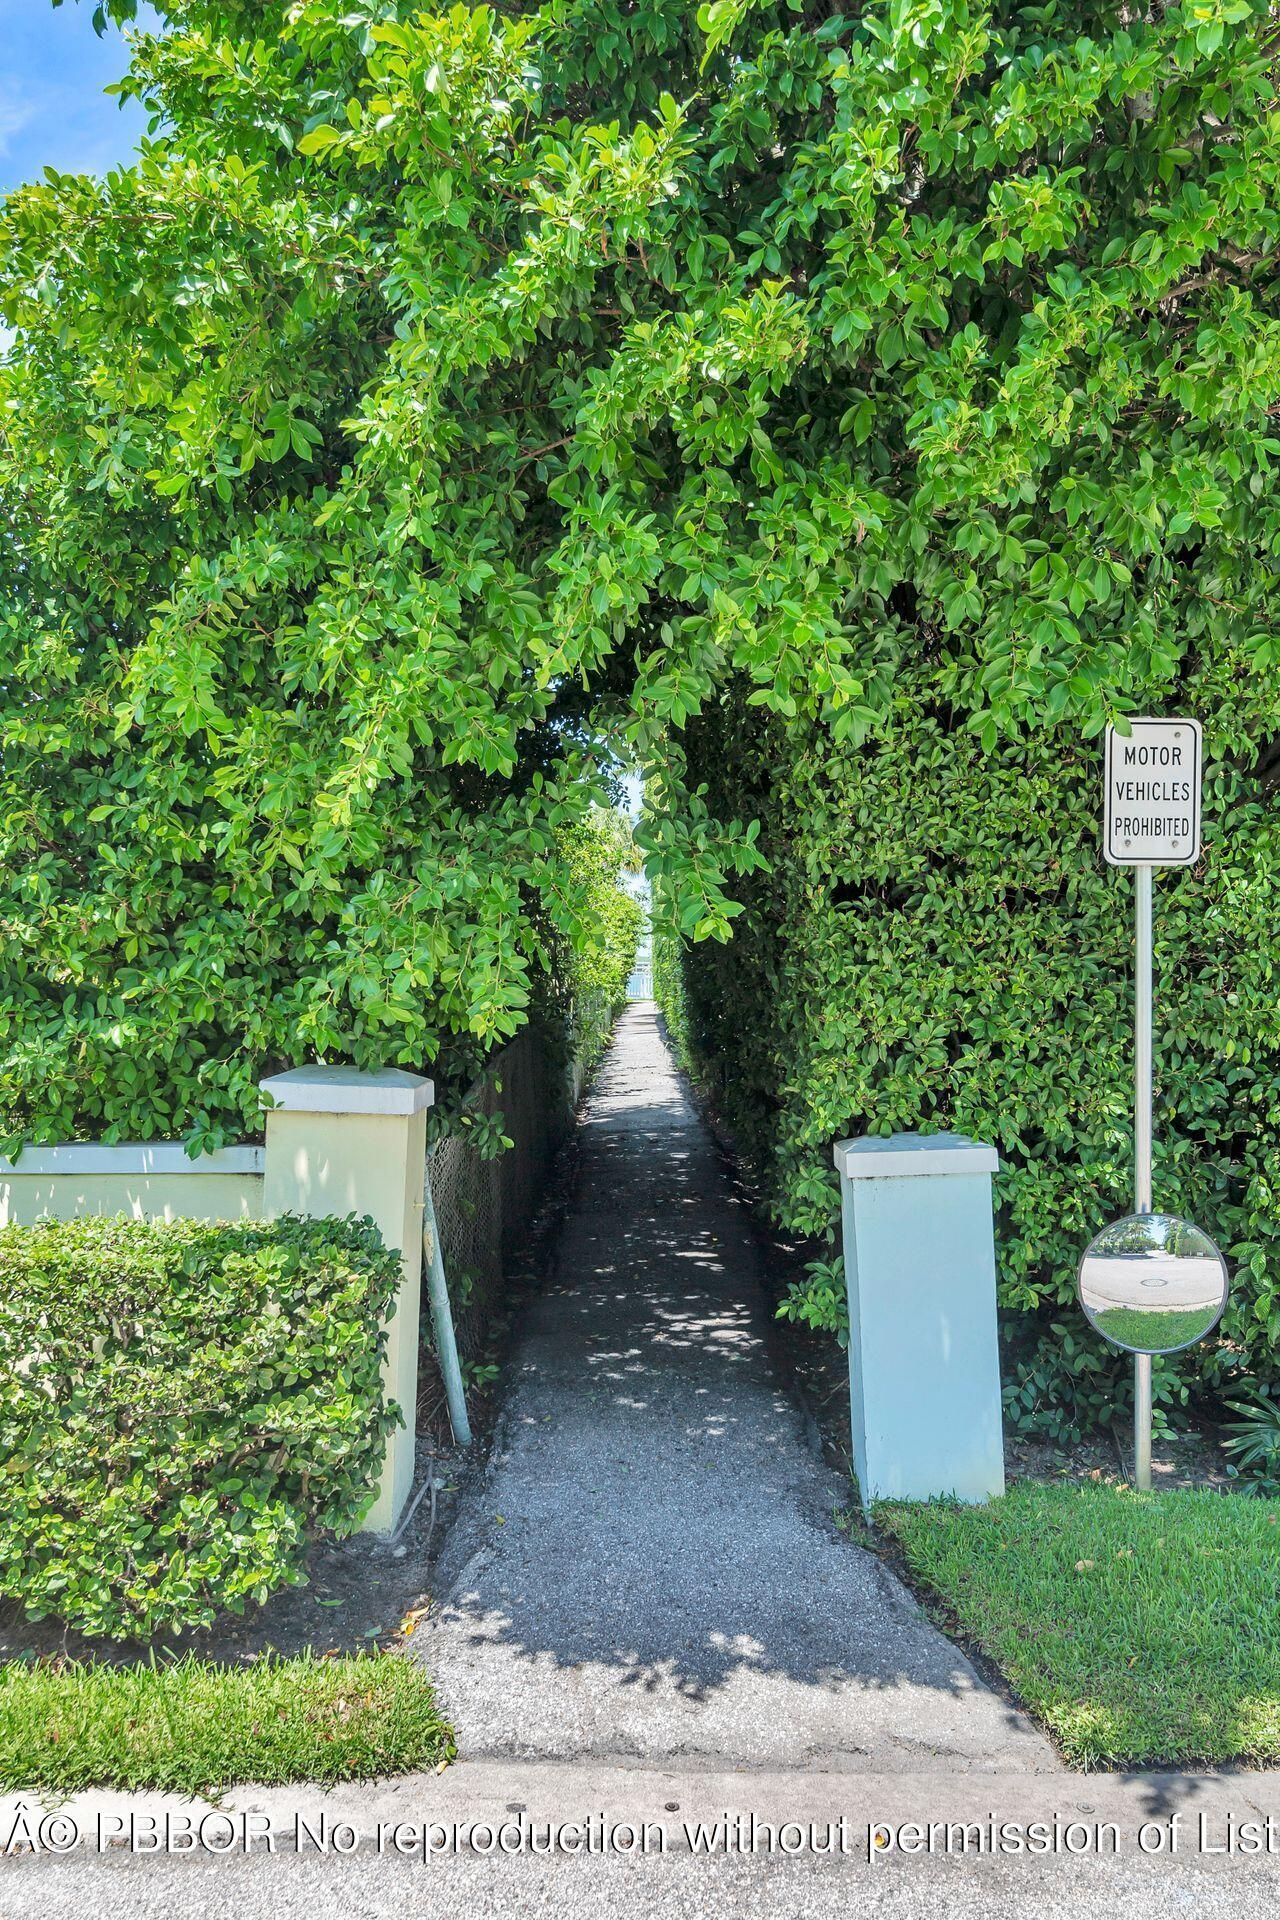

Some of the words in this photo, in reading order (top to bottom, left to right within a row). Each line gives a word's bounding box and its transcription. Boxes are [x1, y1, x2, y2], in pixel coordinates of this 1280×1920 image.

[1124, 746, 1182, 765] MOTOR
[1115, 782, 1190, 801] VEHICLES
[1114, 817, 1190, 836] PROHIBITED
